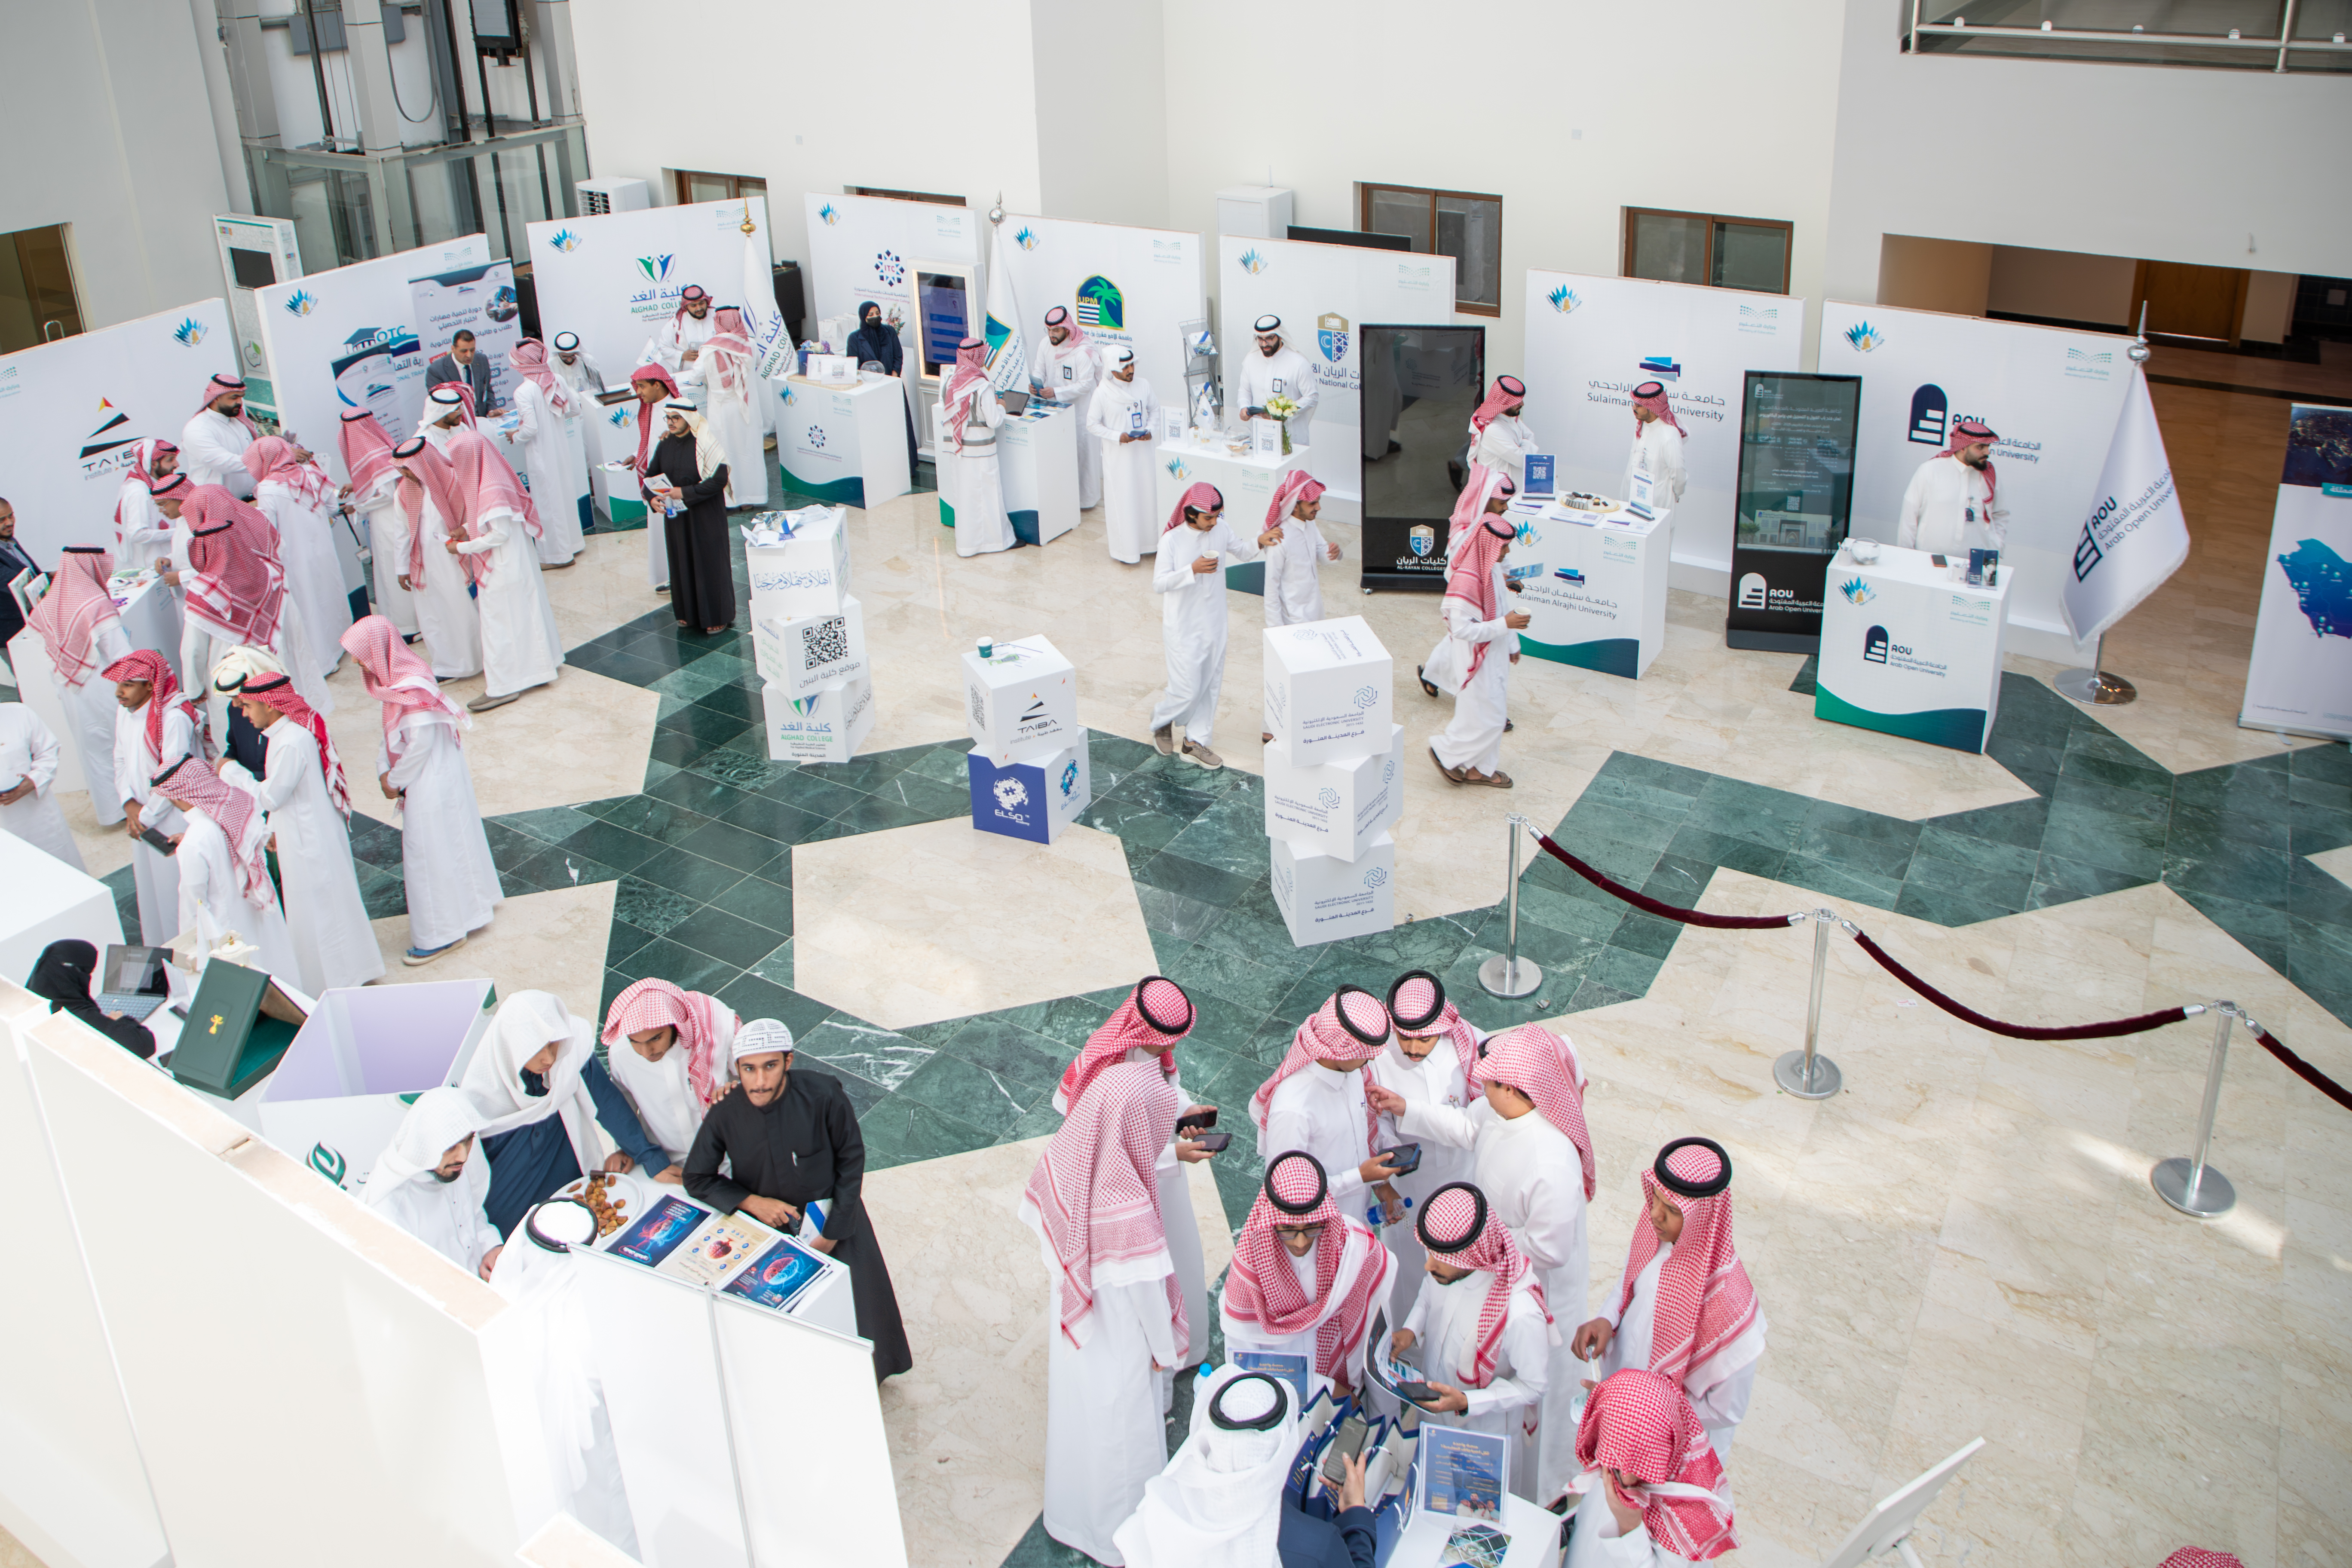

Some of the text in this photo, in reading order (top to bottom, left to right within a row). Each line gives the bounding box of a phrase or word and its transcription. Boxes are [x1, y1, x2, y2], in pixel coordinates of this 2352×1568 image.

[630, 289, 655, 302] الغد
[1078, 296, 1097, 305] UPM
[631, 304, 658, 313] ALGHAD
[438, 319, 462, 331] التحصيلي
[761, 310, 781, 344] كلية
[760, 351, 780, 380] ALGHAD
[1324, 366, 1346, 379] الريان
[1319, 378, 1348, 388] National
[1589, 381, 1633, 393] الراجحي
[1681, 392, 1725, 407] جامعة
[1587, 393, 1724, 422] Sulaiman University
[2012, 439, 2041, 451] الجامعة
[1997, 449, 2039, 464] University
[84, 467, 112, 481] institute
[2091, 496, 2117, 530] AOU
[2104, 510, 2152, 551] Arab Open
[1396, 556, 1446, 566] كليات الريان
[1524, 585, 1617, 608] جامعة سليمان الراجح
[1769, 589, 1794, 598] AOU
[1516, 593, 1617, 620] Sulaiman Alrajhi University
[1891, 644, 1912, 655] AOU
[799, 662, 860, 688] موقع كلية البنين
[1919, 667, 1945, 678] University
[781, 722, 831, 735] كلية الغد
[1017, 720, 1057, 733] TAIBA
[1010, 735, 1031, 744] institute
[1303, 735, 1326, 744] المنورة
[1351, 729, 1364, 738] فرع
[1274, 795, 1294, 804] الإلكترونية
[1295, 801, 1313, 809] السعودية
[995, 809, 1023, 821] ELSO
[1286, 802, 1307, 812] ELECTRONIC
[1308, 810, 1328, 819] UNIVERSITY
[1275, 812, 1295, 822] المنورة
[1296, 819, 1316, 828] المدينة
[1361, 907, 1374, 916] فرع
[1315, 914, 1338, 923] المنورة
